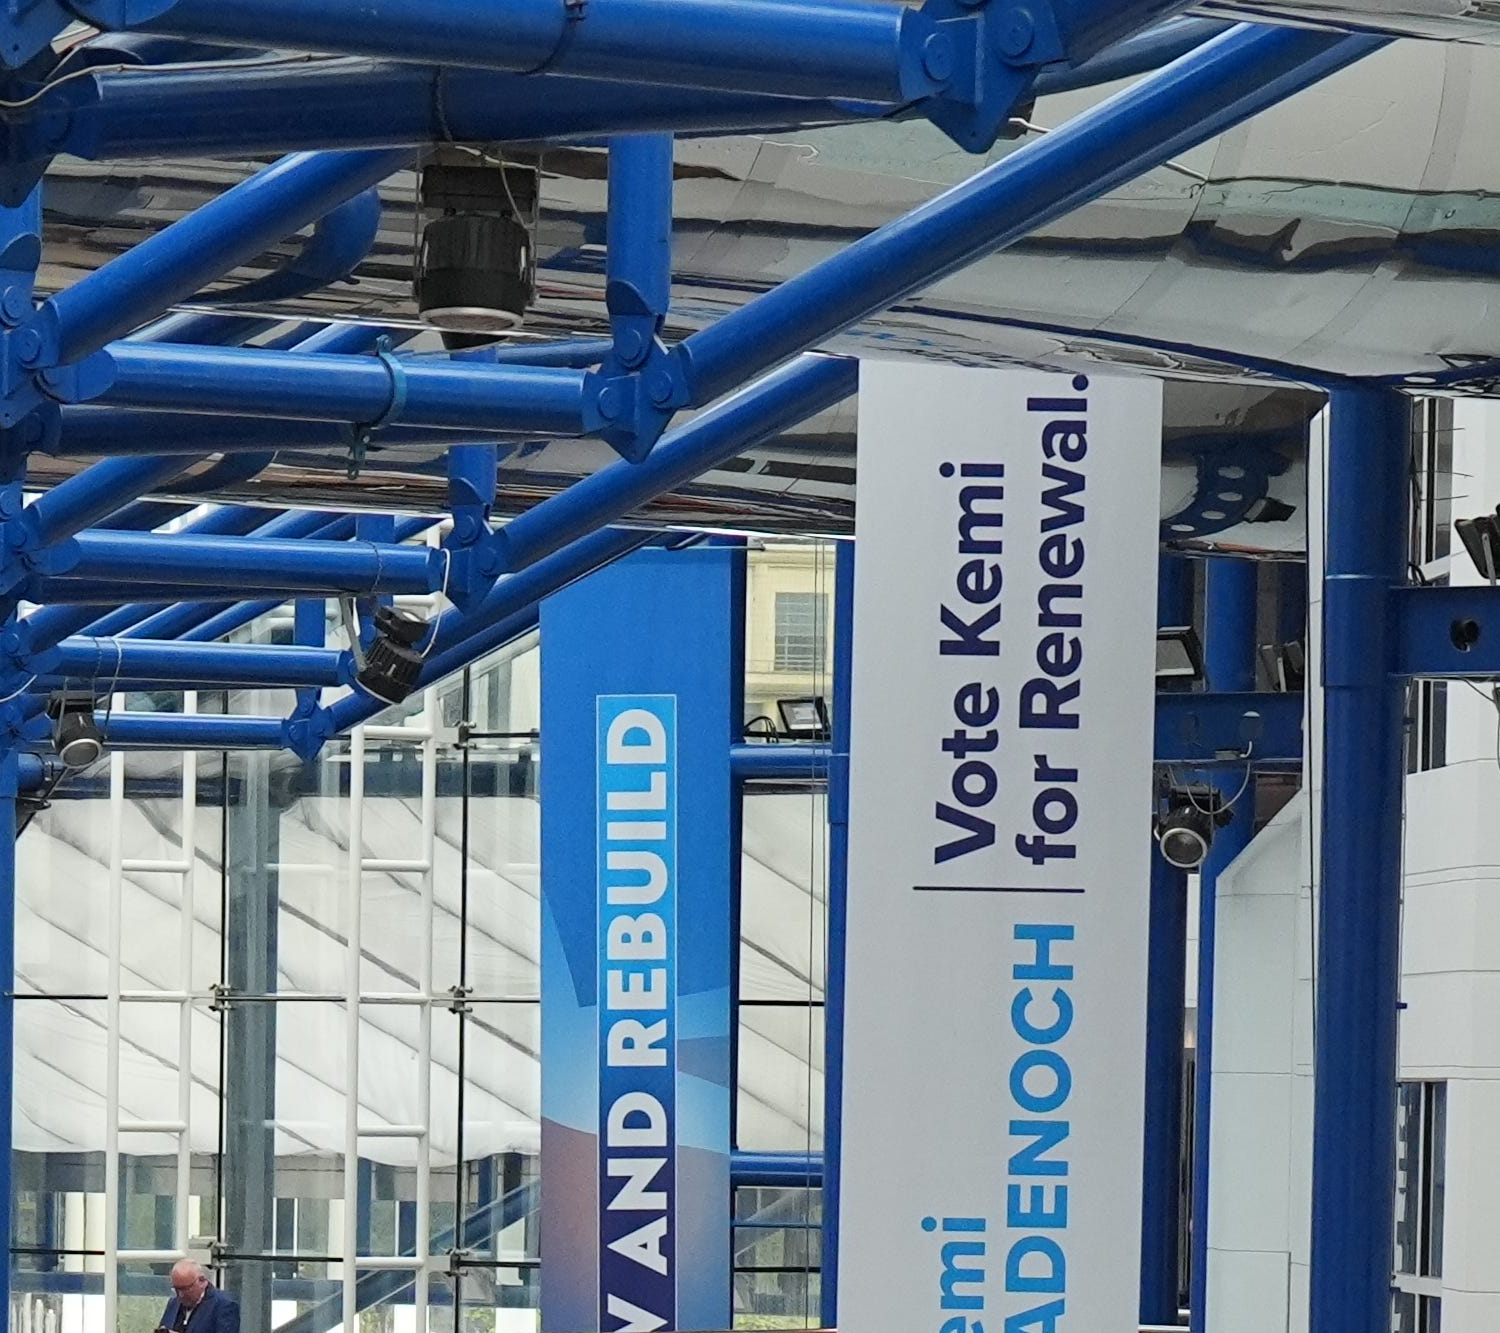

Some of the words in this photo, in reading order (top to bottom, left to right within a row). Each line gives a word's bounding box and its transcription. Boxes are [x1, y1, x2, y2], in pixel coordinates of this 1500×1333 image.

[938, 461, 1006, 658] Kemi
[1019, 373, 1091, 731] Renewal.
[934, 682, 1001, 866] Vote
[1015, 754, 1080, 867] for
[605, 708, 670, 1068] REBUILD
[607, 1092, 670, 1277] AND
